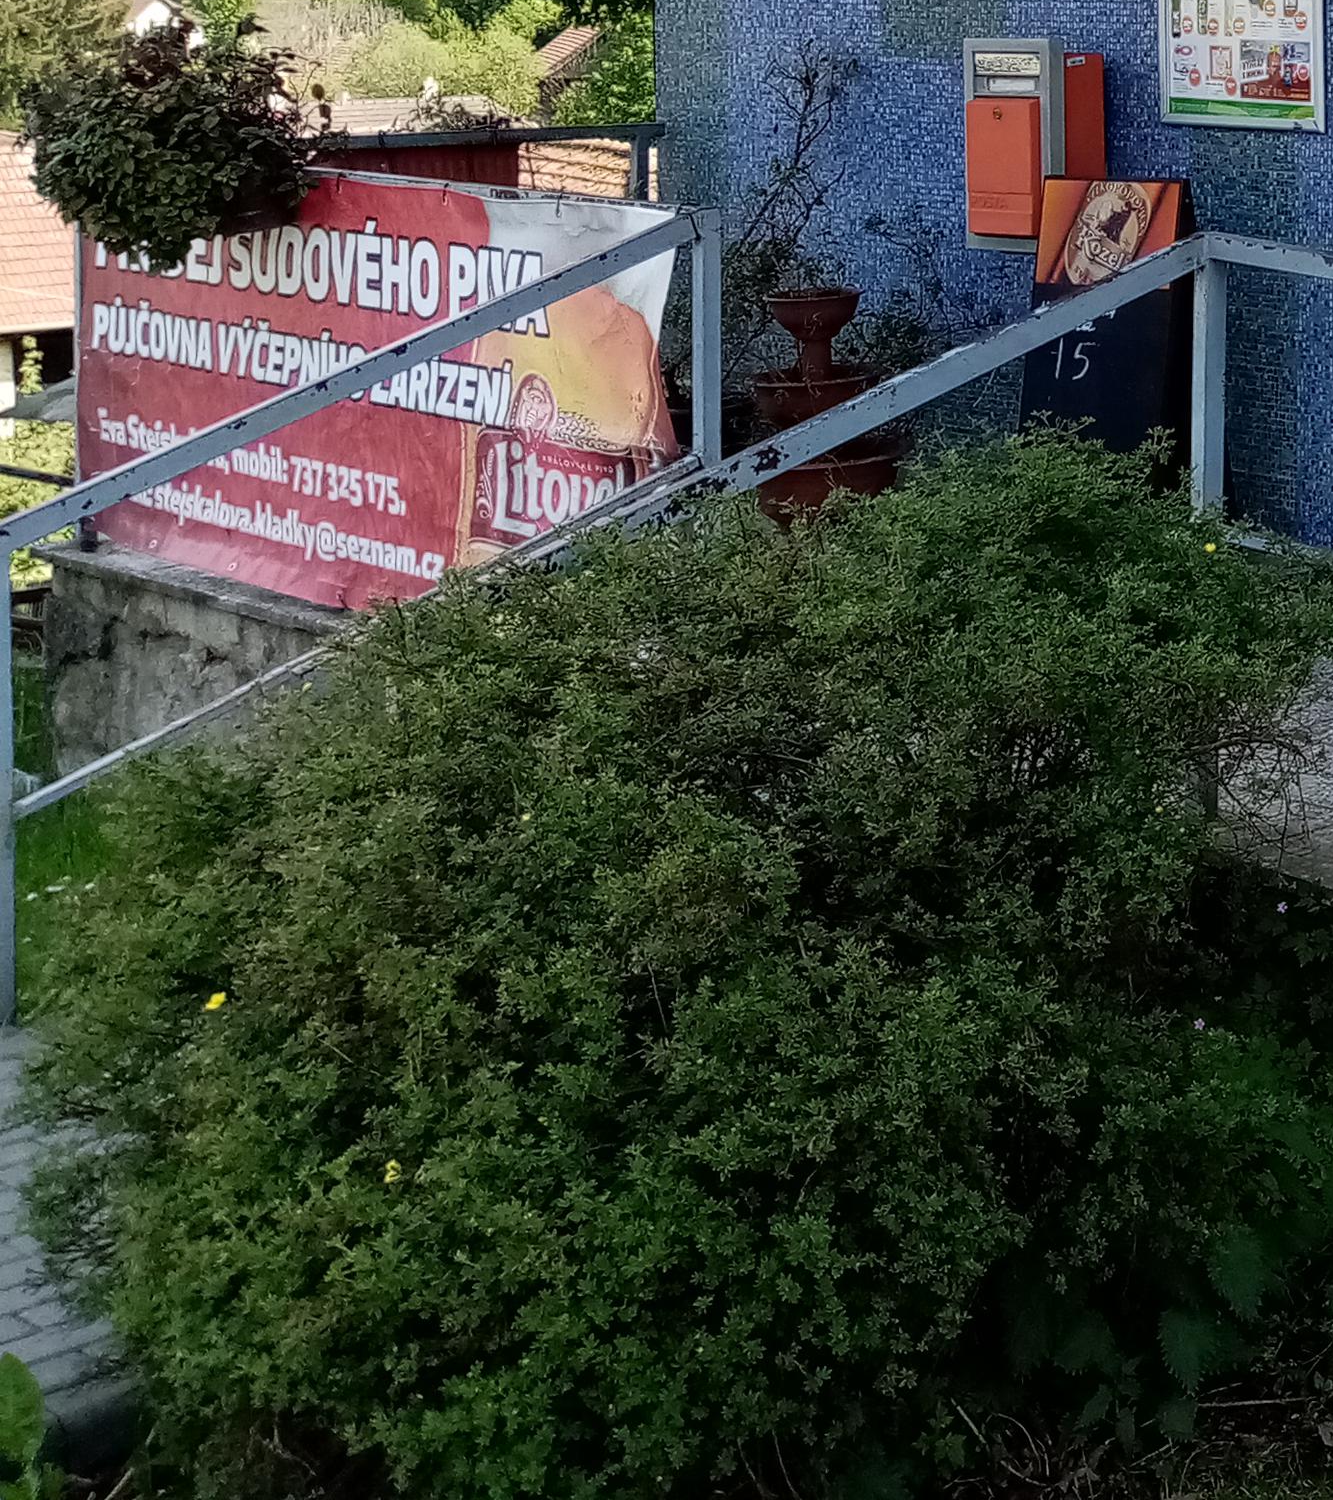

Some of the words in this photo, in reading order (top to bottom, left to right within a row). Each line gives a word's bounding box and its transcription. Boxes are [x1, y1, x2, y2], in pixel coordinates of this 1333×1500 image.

[228, 217, 440, 319] SUDOVÉHO
[448, 242, 550, 338] PIVA
[1076, 224, 1126, 270] Kozel
[91, 295, 213, 372] PŮJČOVNA
[232, 442, 289, 485] mobil:
[290, 455, 323, 497] 737
[325, 464, 363, 508] 325
